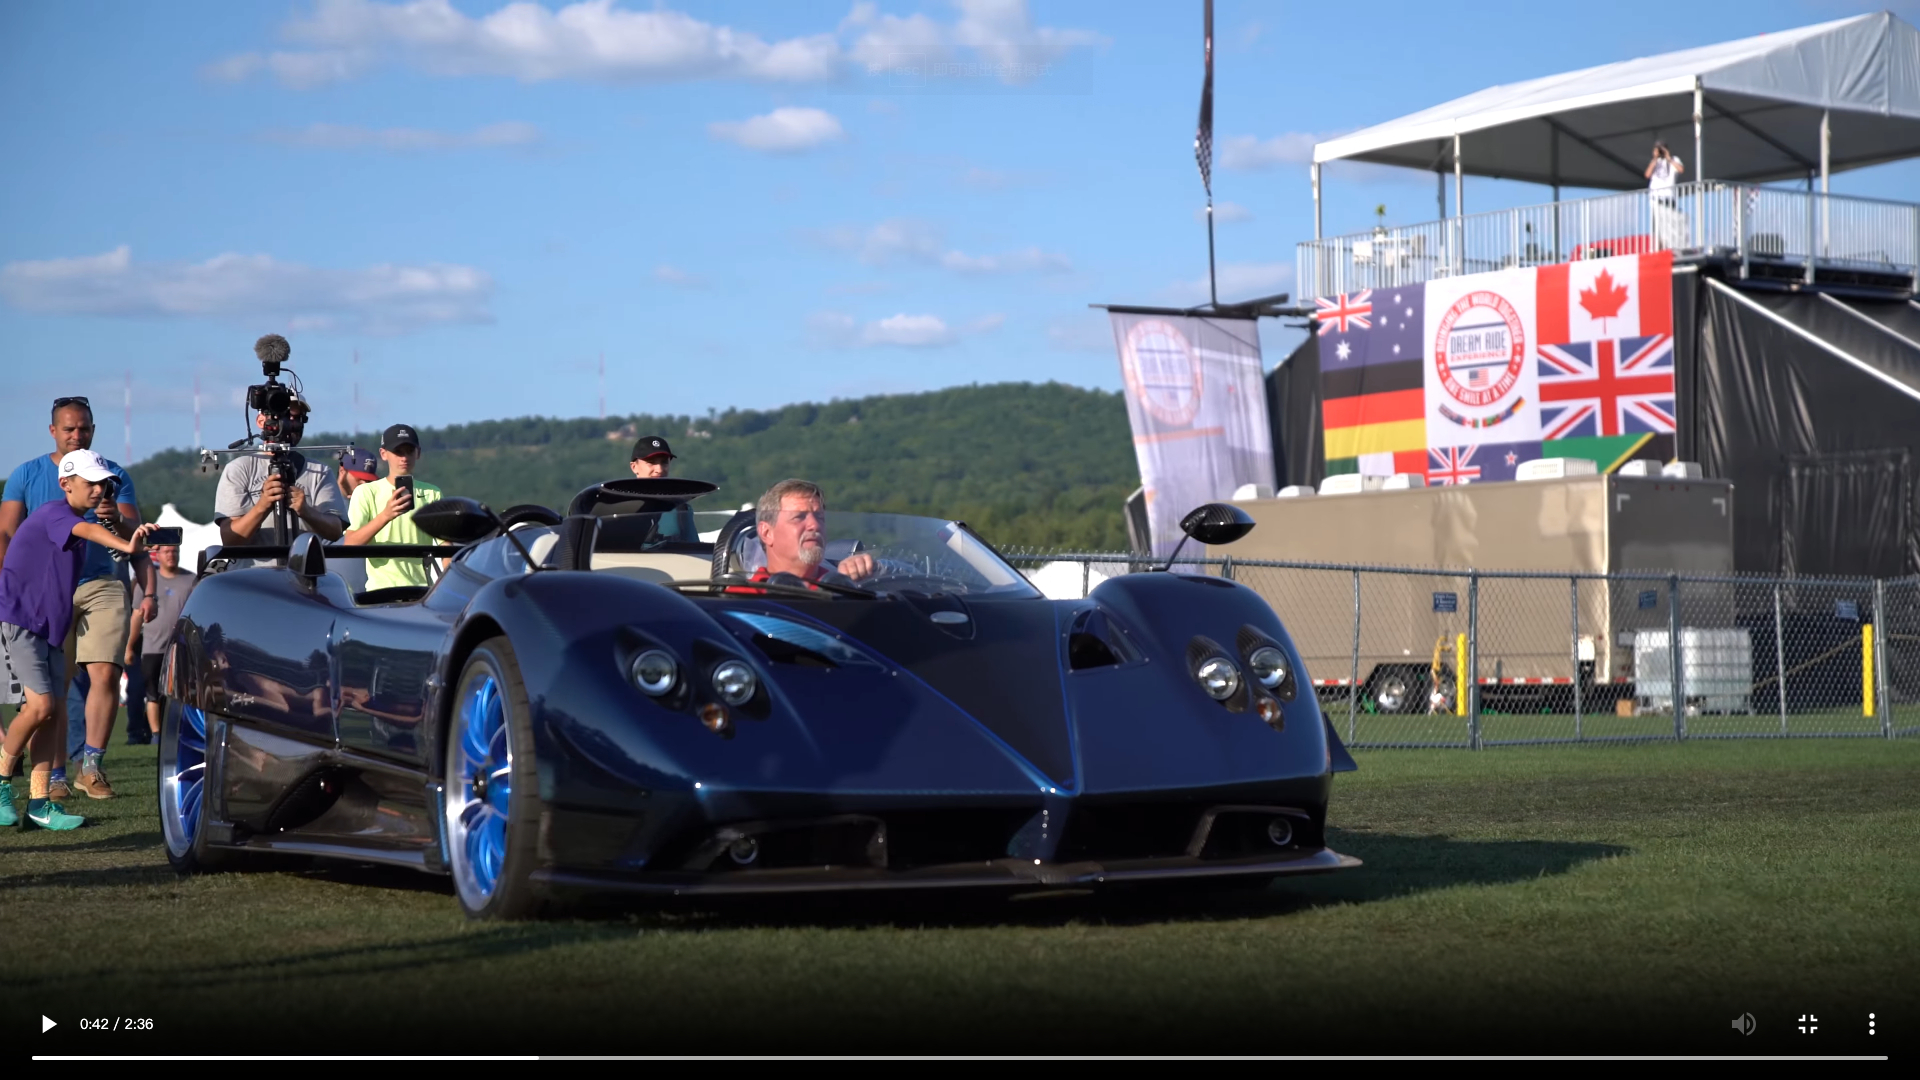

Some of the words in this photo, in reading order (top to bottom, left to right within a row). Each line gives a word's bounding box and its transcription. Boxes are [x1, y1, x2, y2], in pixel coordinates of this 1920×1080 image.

[1471, 292, 1500, 309] WORLD
[1450, 335, 1481, 354] DREAM
[1485, 331, 1507, 350] RIDE
[1451, 350, 1507, 362] EXPERIENCE
[1459, 389, 1481, 405] SMILE
[1481, 390, 1492, 404] AT
[1498, 371, 1516, 395] TIME
